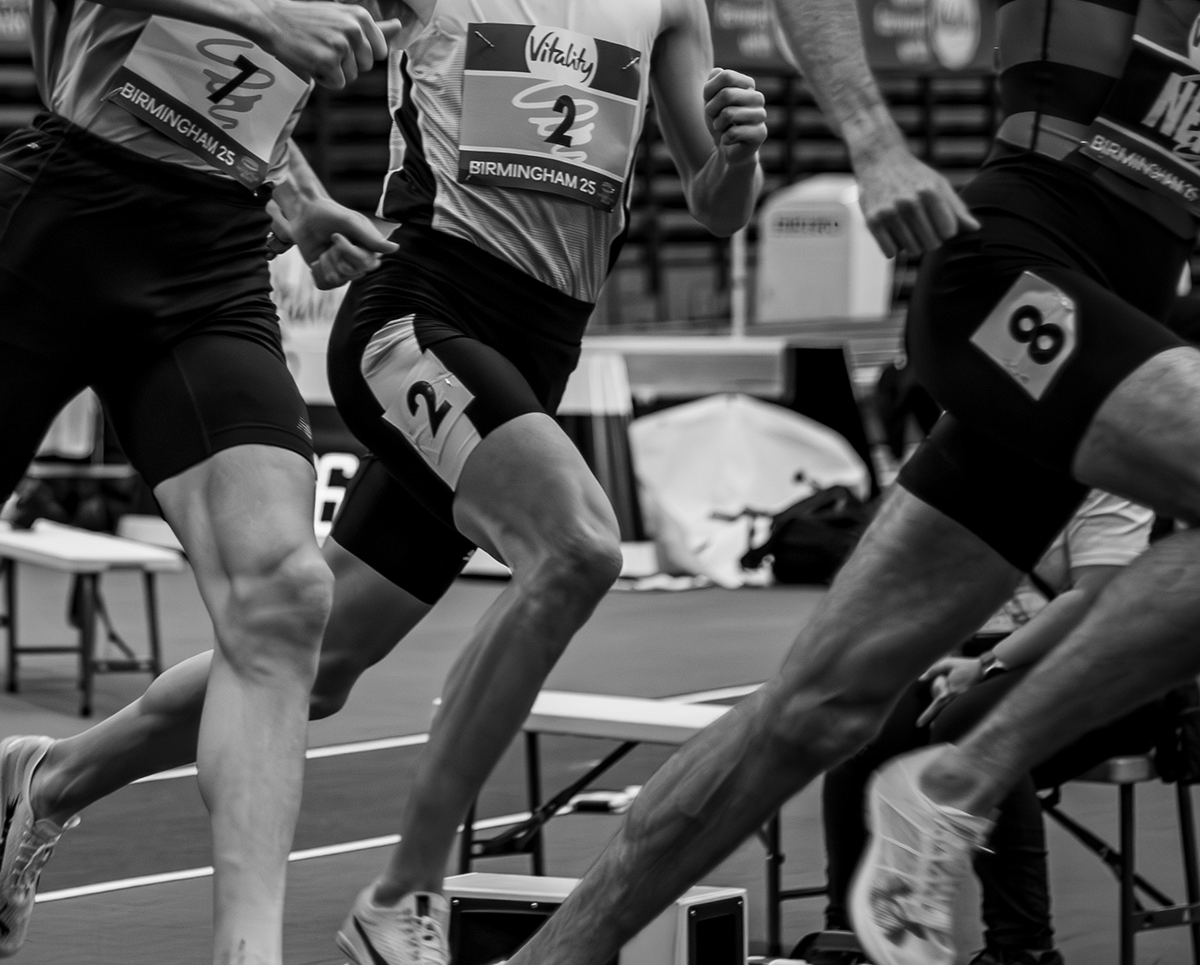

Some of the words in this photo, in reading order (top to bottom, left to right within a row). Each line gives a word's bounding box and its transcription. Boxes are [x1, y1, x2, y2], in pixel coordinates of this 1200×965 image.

[206, 53, 260, 104] 7
[529, 32, 593, 84] Vitality
[119, 82, 220, 157] BIRMINGHAM
[216, 144, 236, 167] 25
[543, 94, 577, 148] 2
[1140, 71, 1200, 157] NE
[468, 160, 578, 190] BIRMINGHAM
[578, 176, 597, 196] 25
[1009, 304, 1066, 366] 8
[406, 380, 453, 439] 2
[313, 452, 360, 538] 6
